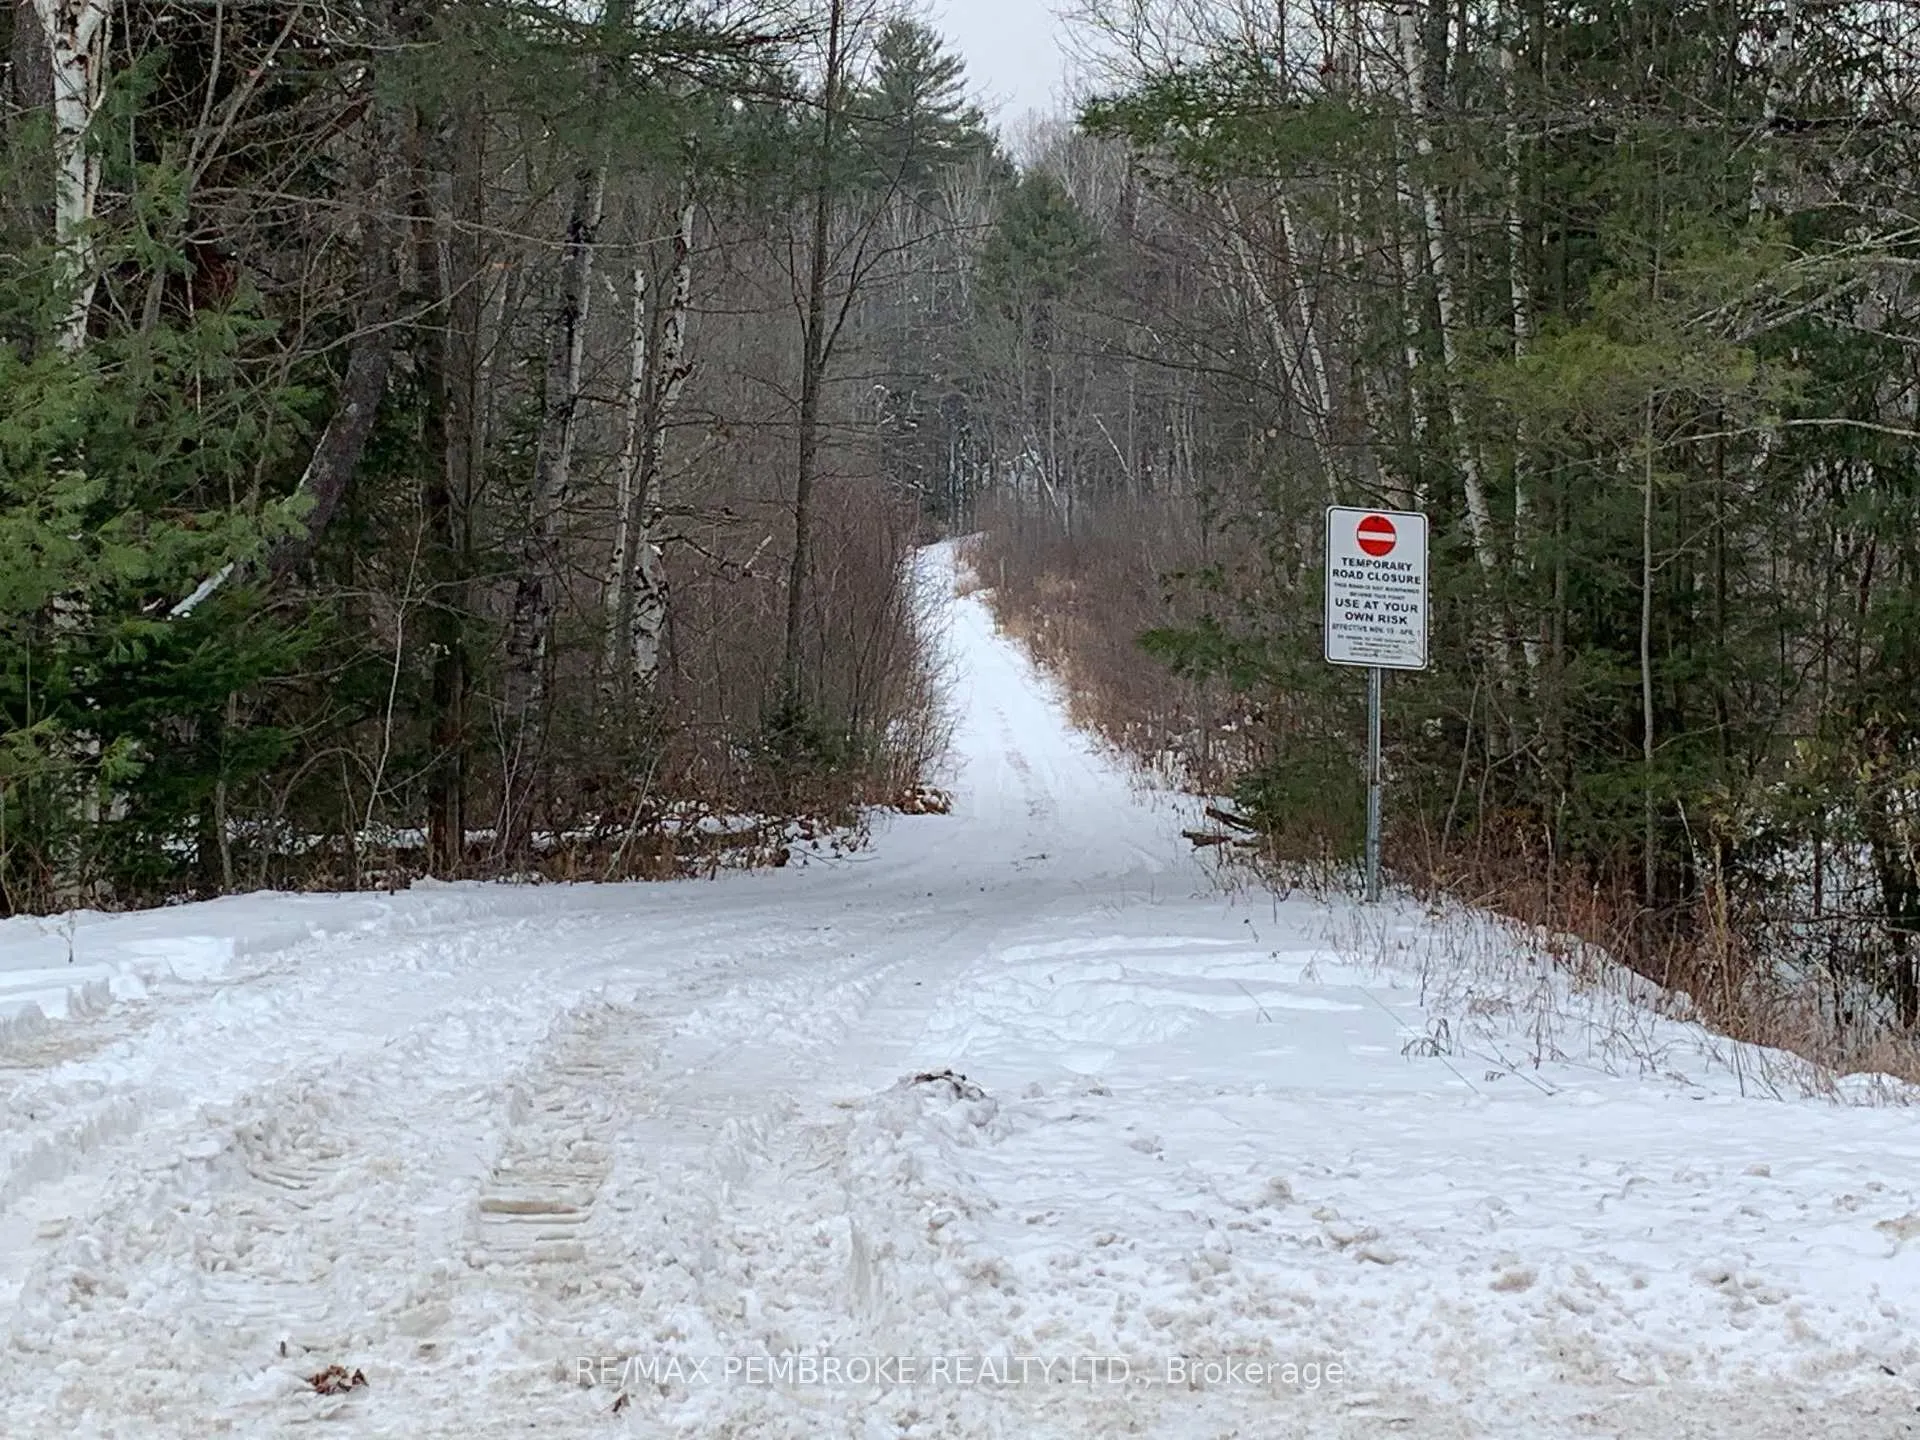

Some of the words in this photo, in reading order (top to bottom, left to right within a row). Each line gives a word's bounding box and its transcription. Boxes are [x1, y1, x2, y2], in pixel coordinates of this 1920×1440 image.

[1341, 557, 1412, 572] TEMPORARY
[1332, 568, 1364, 580] ROAD
[1367, 572, 1421, 584] CLOSURE
[1335, 598, 1360, 608] USE
[1364, 600, 1379, 610] AT
[1384, 602, 1418, 614] YOUR
[1344, 612, 1374, 622] OWN
[1378, 614, 1408, 625] RISK
[1332, 623, 1368, 632] EFFECTIVE
